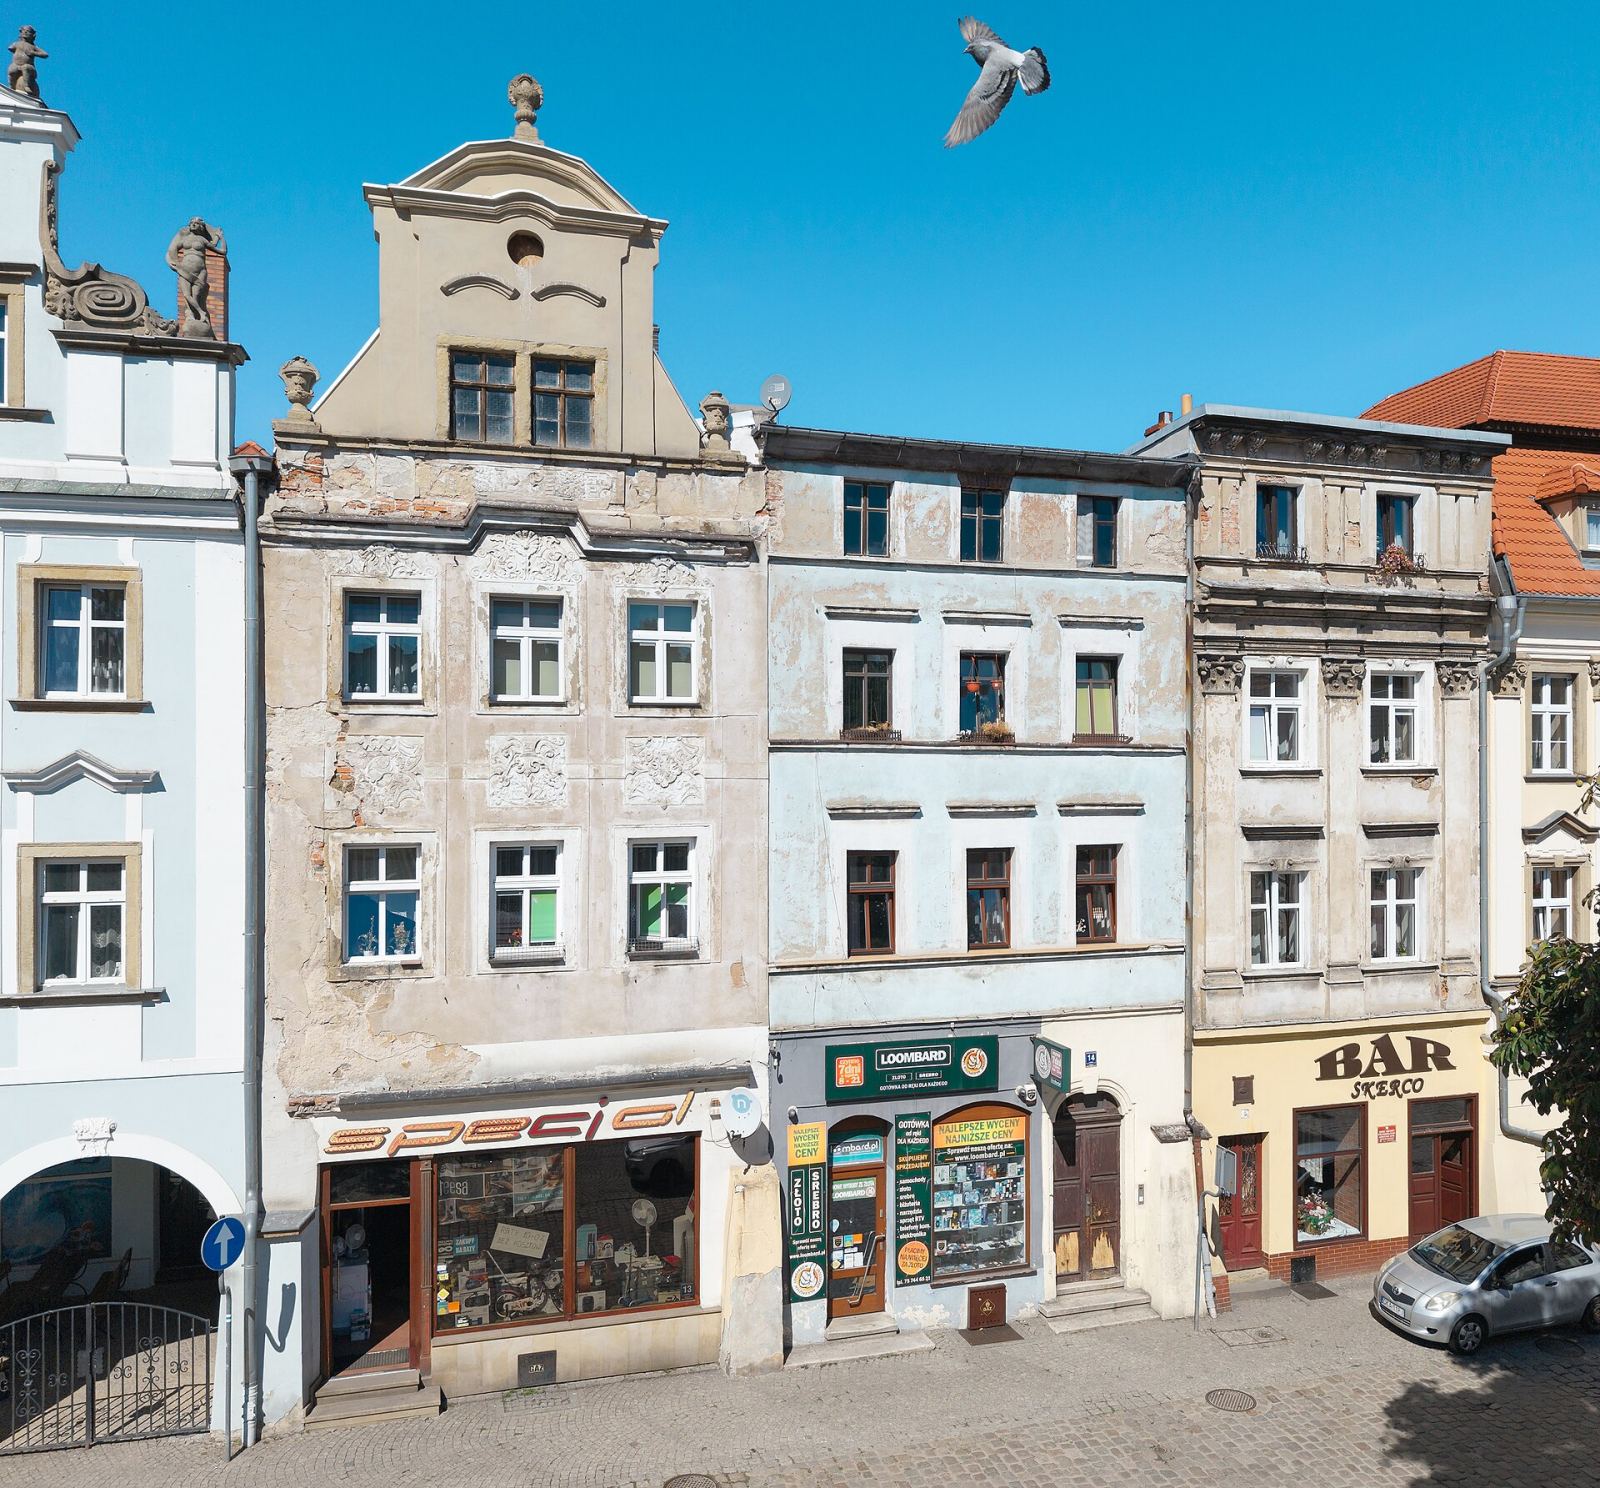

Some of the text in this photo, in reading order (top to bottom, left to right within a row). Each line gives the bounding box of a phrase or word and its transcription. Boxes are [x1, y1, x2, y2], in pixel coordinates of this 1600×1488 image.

[880, 1050, 947, 1065] LOOMBARD
[1314, 1033, 1457, 1081] BAR
[1351, 1077, 1424, 1100] SKERCO
[898, 1119, 929, 1129] GOTÓWKA
[938, 1119, 1020, 1135] NAJLEPSZE WYCENY
[793, 1127, 820, 1135] NAJLEPSZE
[945, 1129, 1014, 1144] NAJNIŻSZE CENY
[793, 1133, 820, 1142] WYCENY
[795, 1148, 818, 1158] CENY
[947, 1146, 970, 1155] Sprawdź
[954, 1151, 1006, 1161] www.loombard.pl
[793, 1178, 803, 1226] ZŁOTO
[811, 1171, 821, 1229] SREBRO
[682, 1285, 692, 1294] 13
